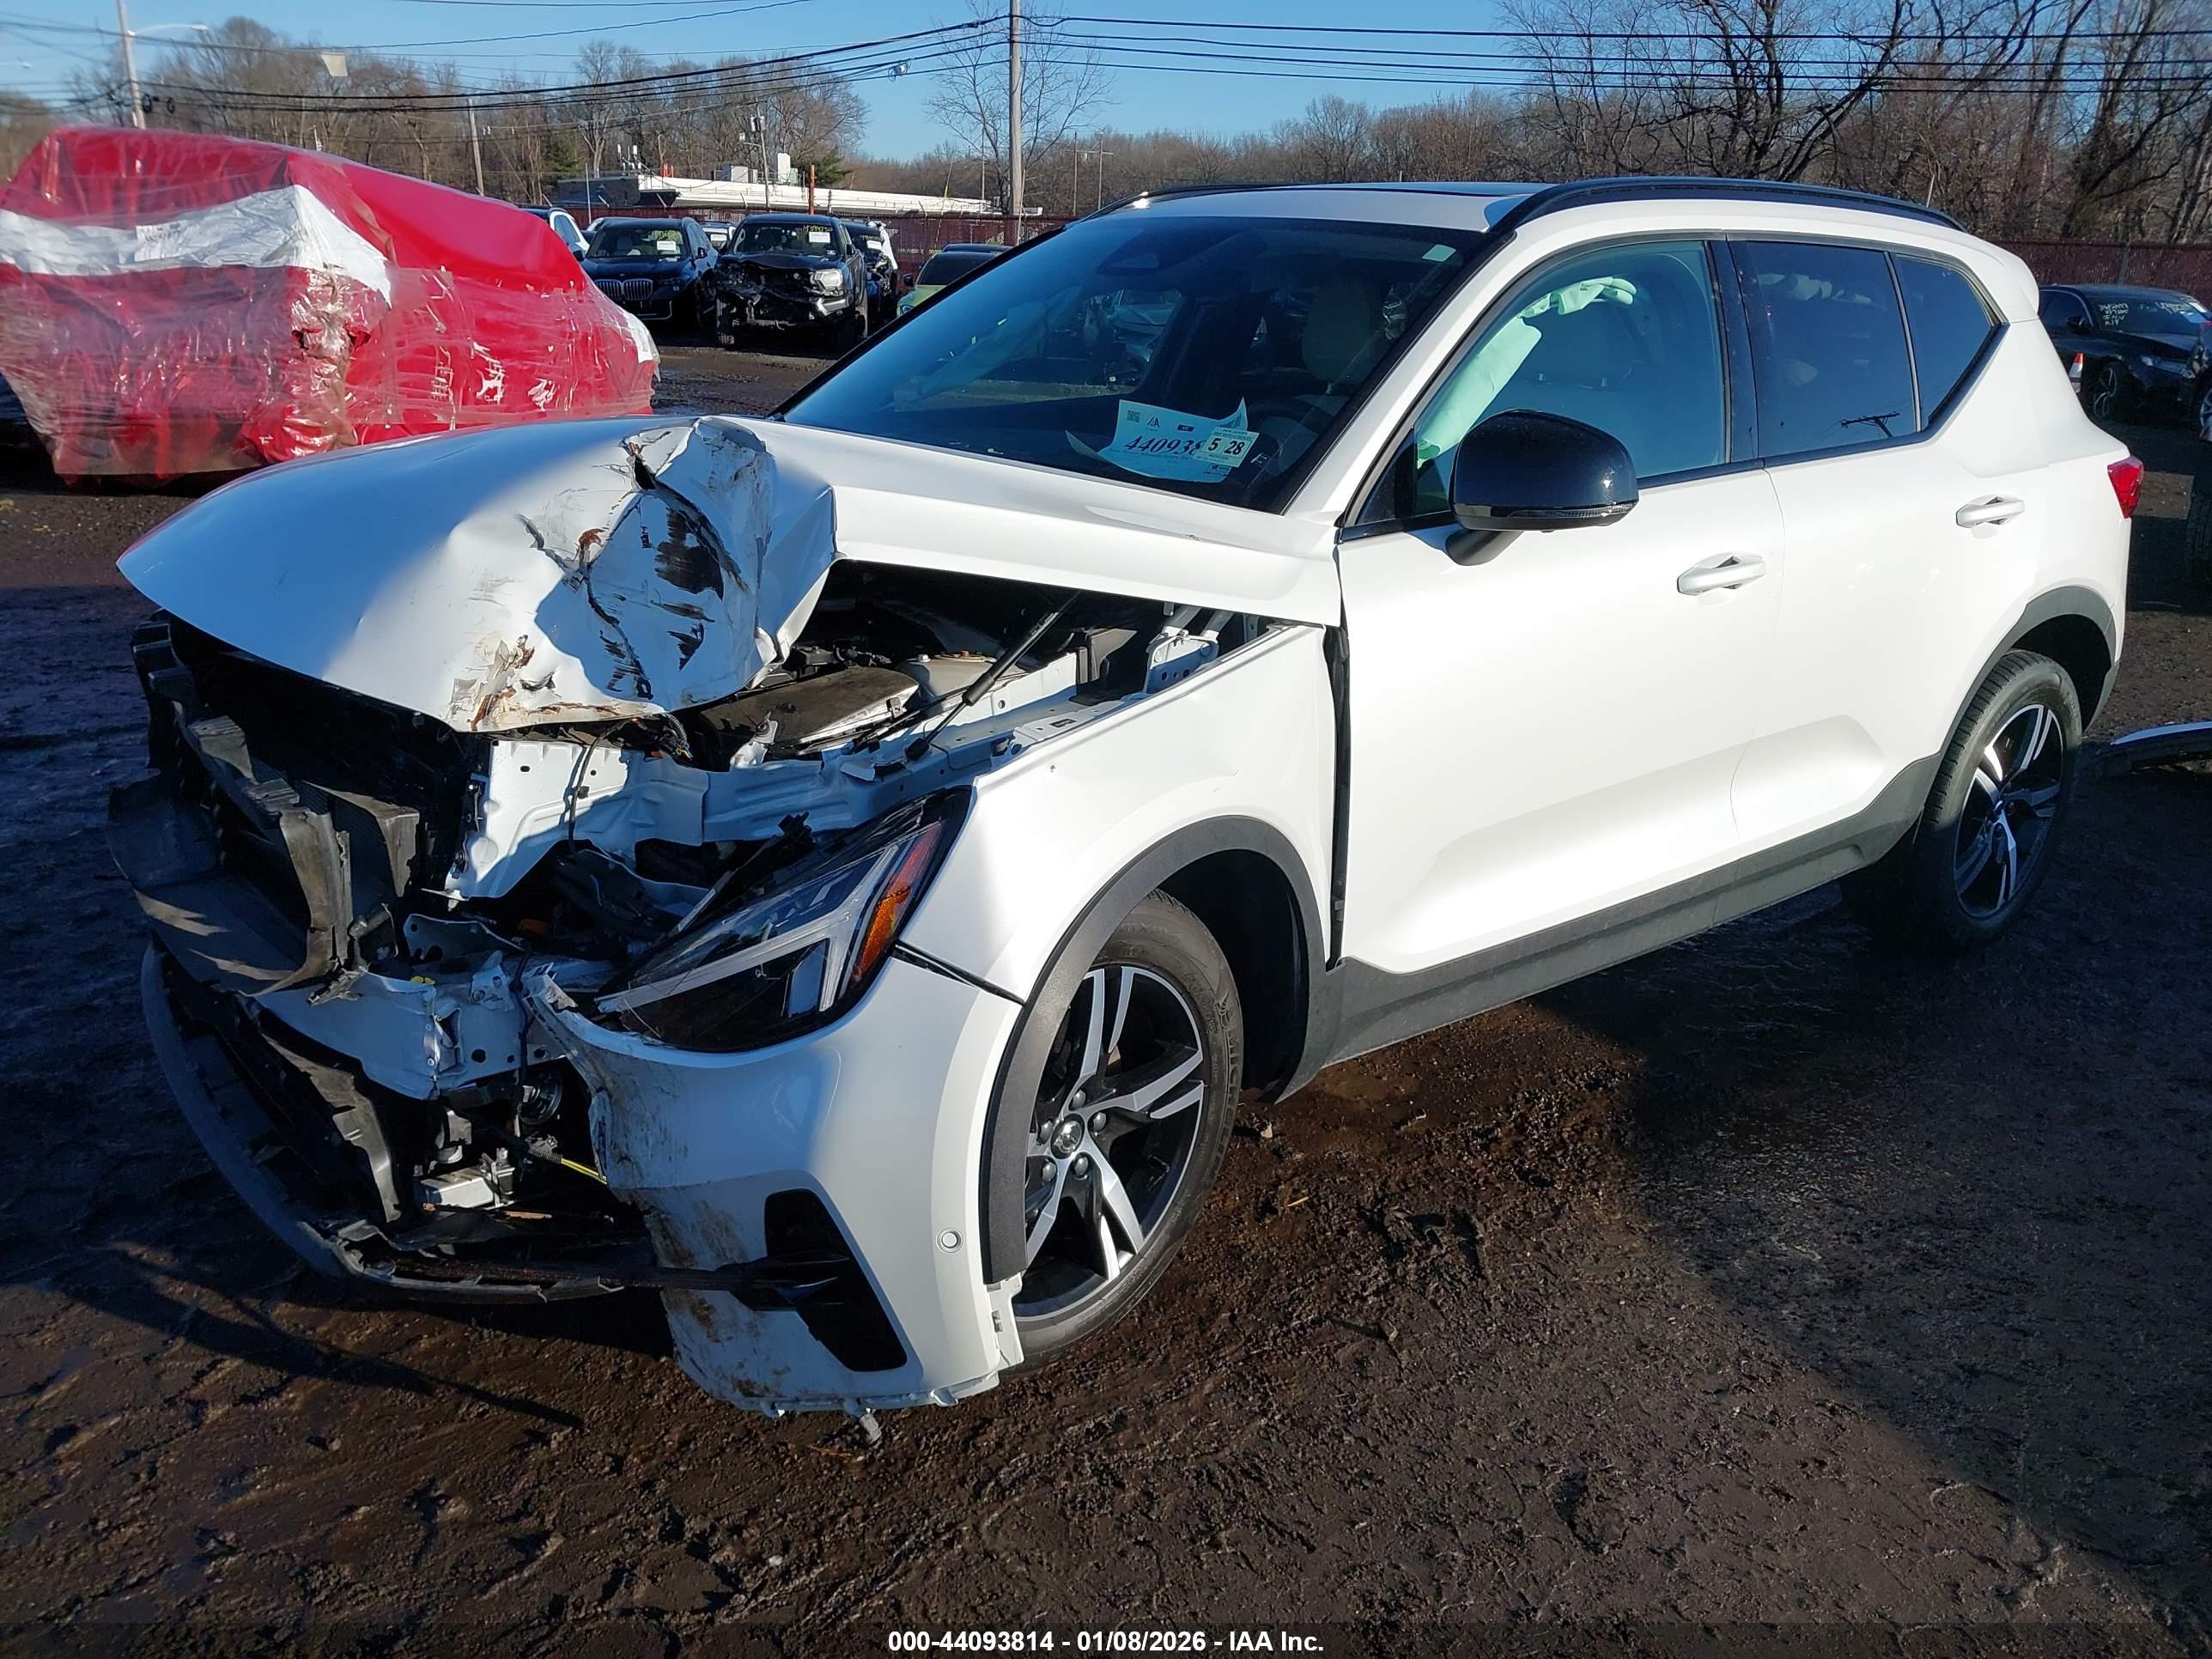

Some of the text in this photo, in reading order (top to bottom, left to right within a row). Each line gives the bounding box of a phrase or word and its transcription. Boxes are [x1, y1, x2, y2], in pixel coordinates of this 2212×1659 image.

[1207, 437, 1245, 455] 5 28
[1207, 1030, 1241, 1183] MICHELIN
